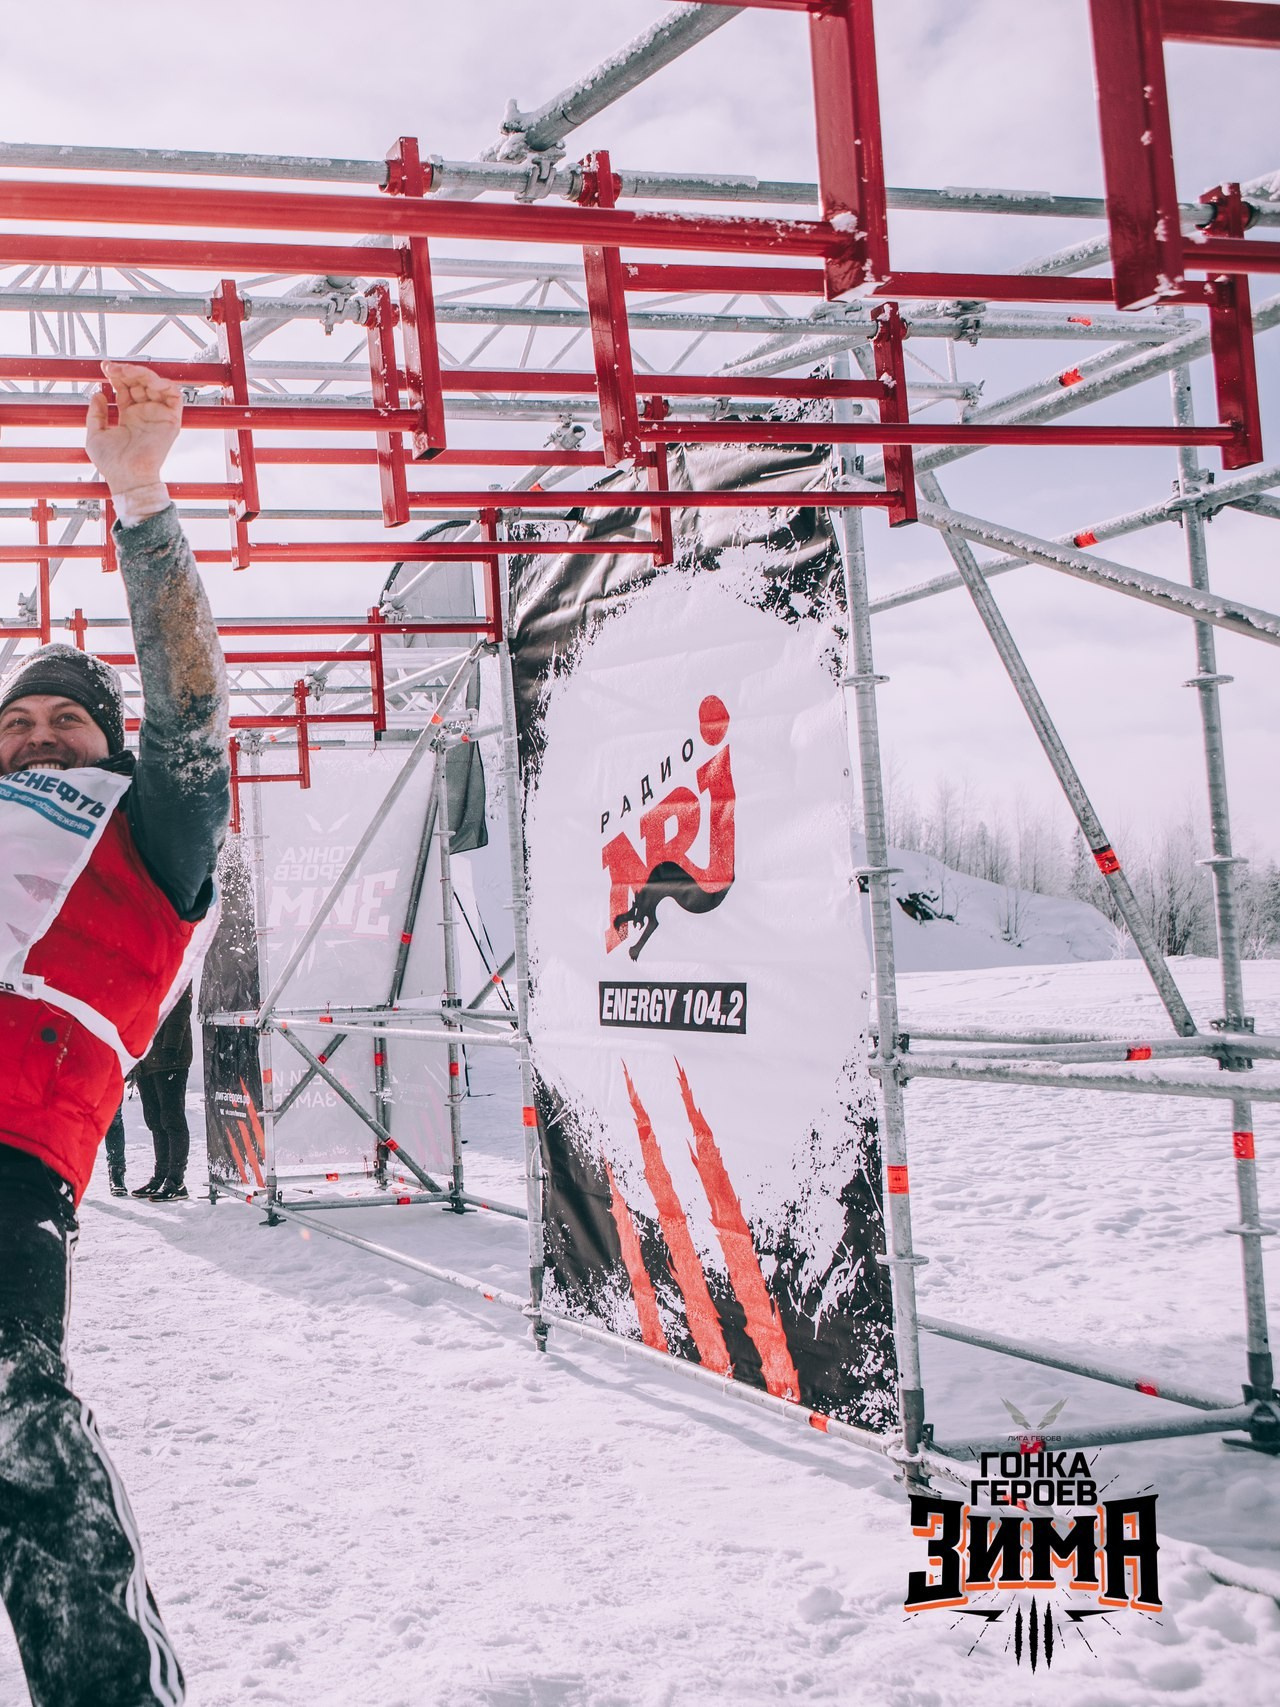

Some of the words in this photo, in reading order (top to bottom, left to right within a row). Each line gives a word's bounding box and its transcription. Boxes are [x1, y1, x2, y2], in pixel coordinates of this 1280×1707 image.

[601, 738, 694, 834] РАДИО
[602, 987, 677, 1023] ENERGY
[682, 989, 744, 1026] 104.2
